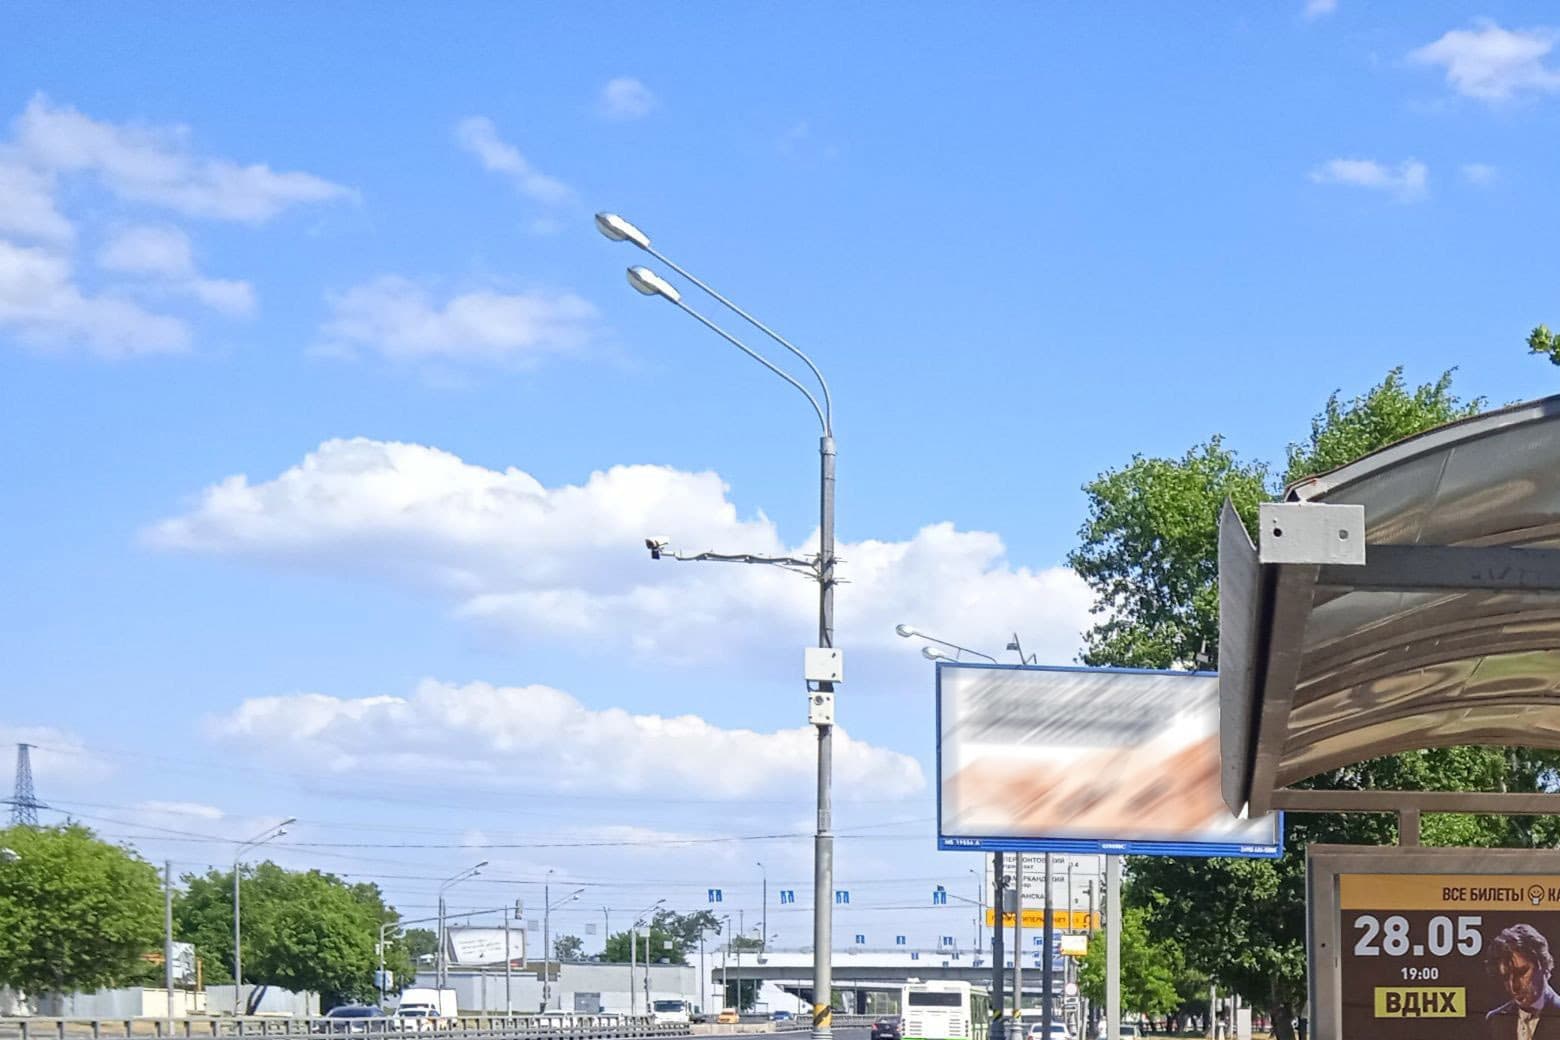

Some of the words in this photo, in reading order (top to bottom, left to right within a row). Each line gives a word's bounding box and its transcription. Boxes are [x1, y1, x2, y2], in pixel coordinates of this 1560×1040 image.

[1442, 887, 1467, 901] ВСЕ
[1470, 887, 1524, 901] БИЛЕТЫ
[1353, 915, 1483, 957] 28.05
[1400, 967, 1439, 981] 19:00
[1385, 991, 1456, 1017] ВДНХ
